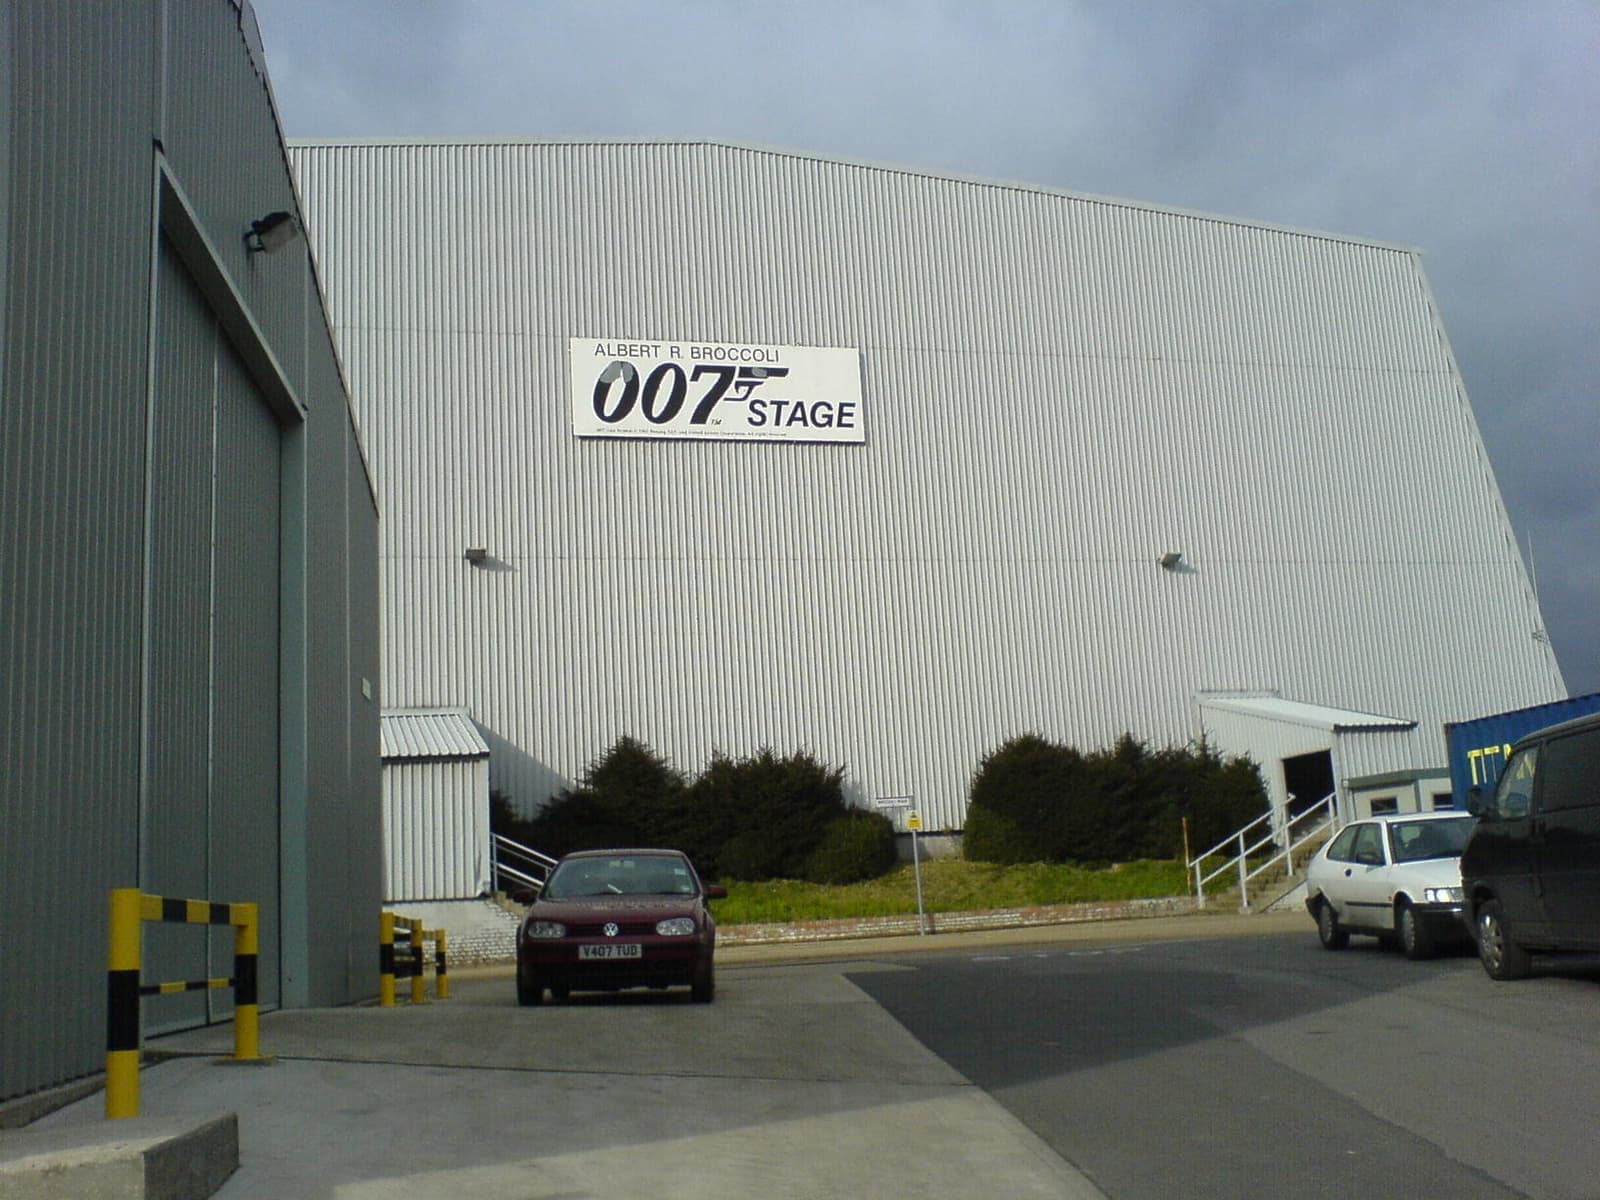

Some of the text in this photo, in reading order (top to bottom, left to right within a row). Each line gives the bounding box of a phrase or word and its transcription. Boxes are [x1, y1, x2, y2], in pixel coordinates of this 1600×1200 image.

[593, 343, 662, 358] ALBERT
[690, 346, 780, 362] BROCCOLI
[592, 360, 738, 425] 007
[747, 399, 857, 429] STAGE
